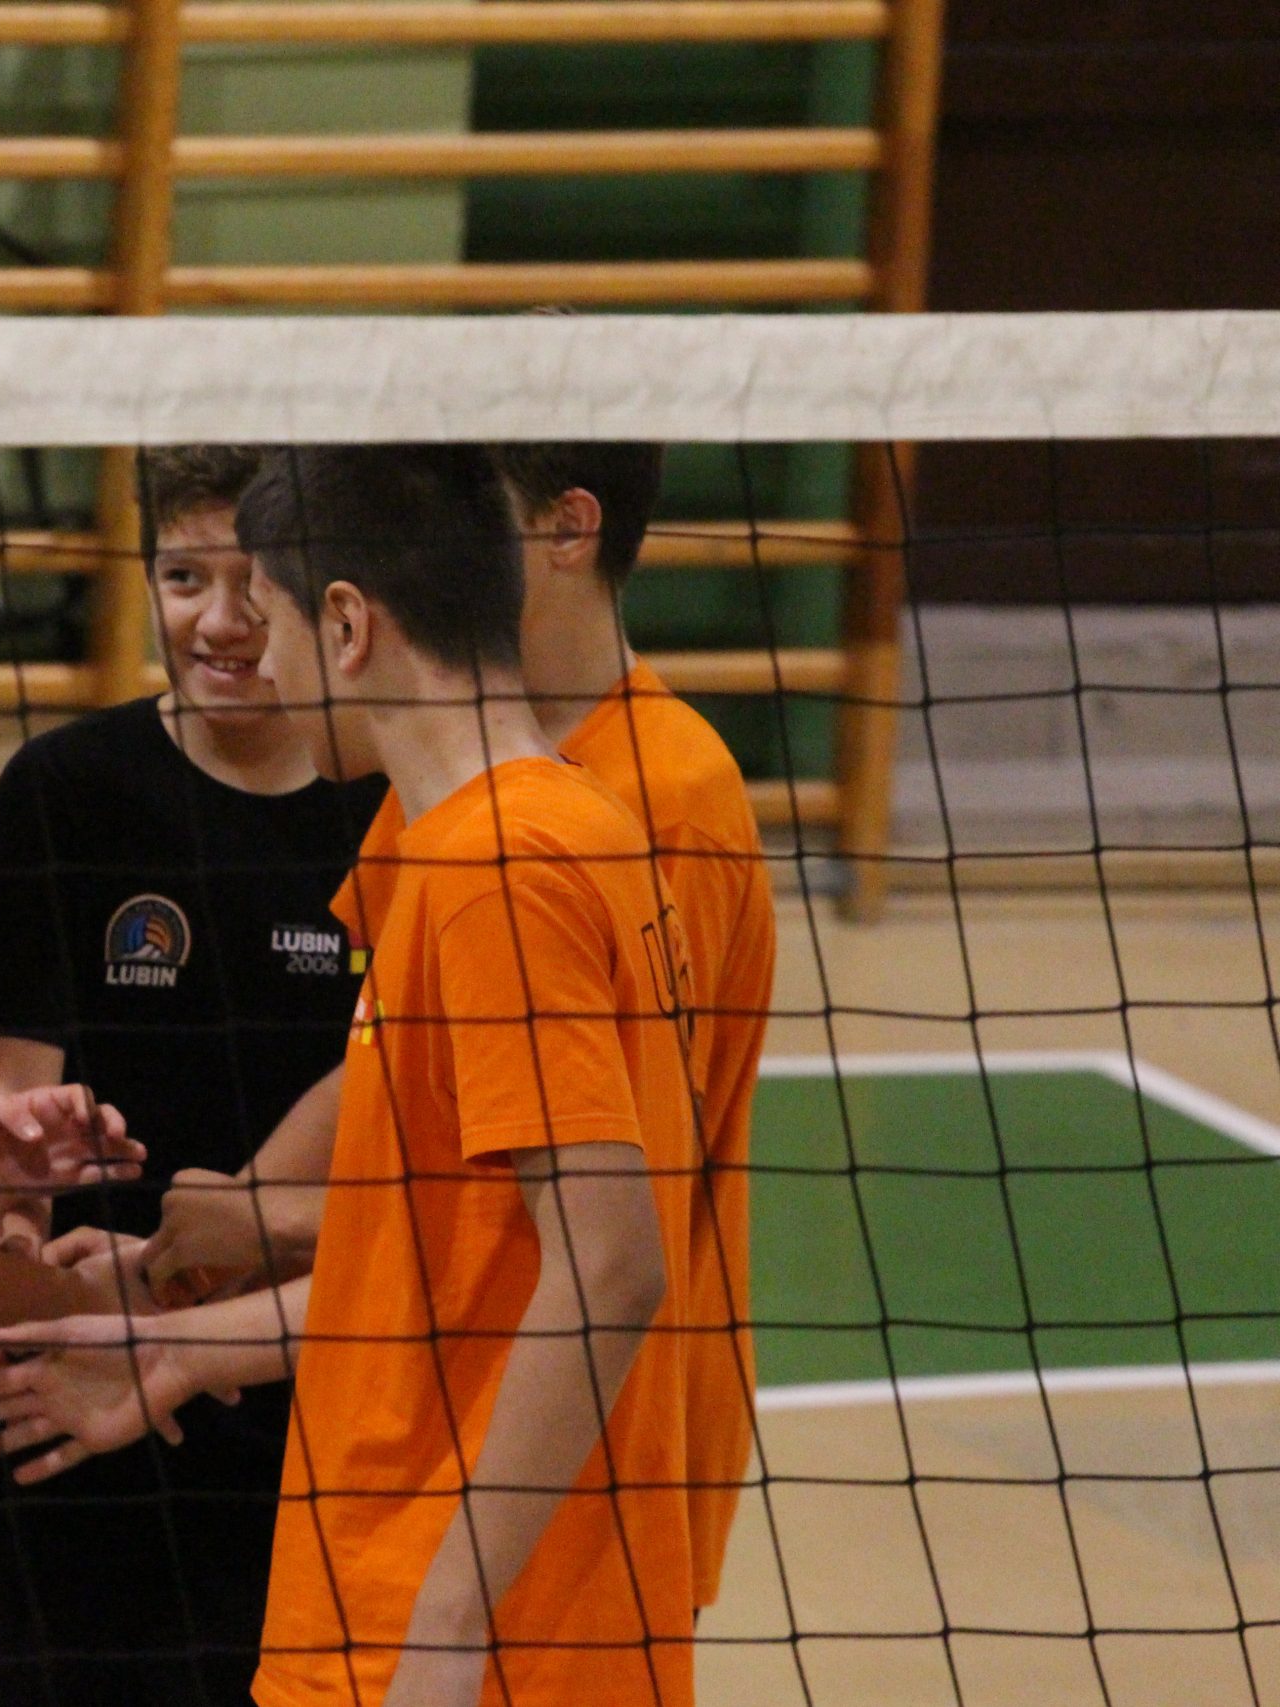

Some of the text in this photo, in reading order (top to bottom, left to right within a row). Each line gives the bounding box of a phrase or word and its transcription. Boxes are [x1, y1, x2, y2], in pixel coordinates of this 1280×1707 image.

[272, 930, 341, 955] LUBIN
[105, 964, 177, 987] LUBIN
[286, 953, 339, 975] 2006
